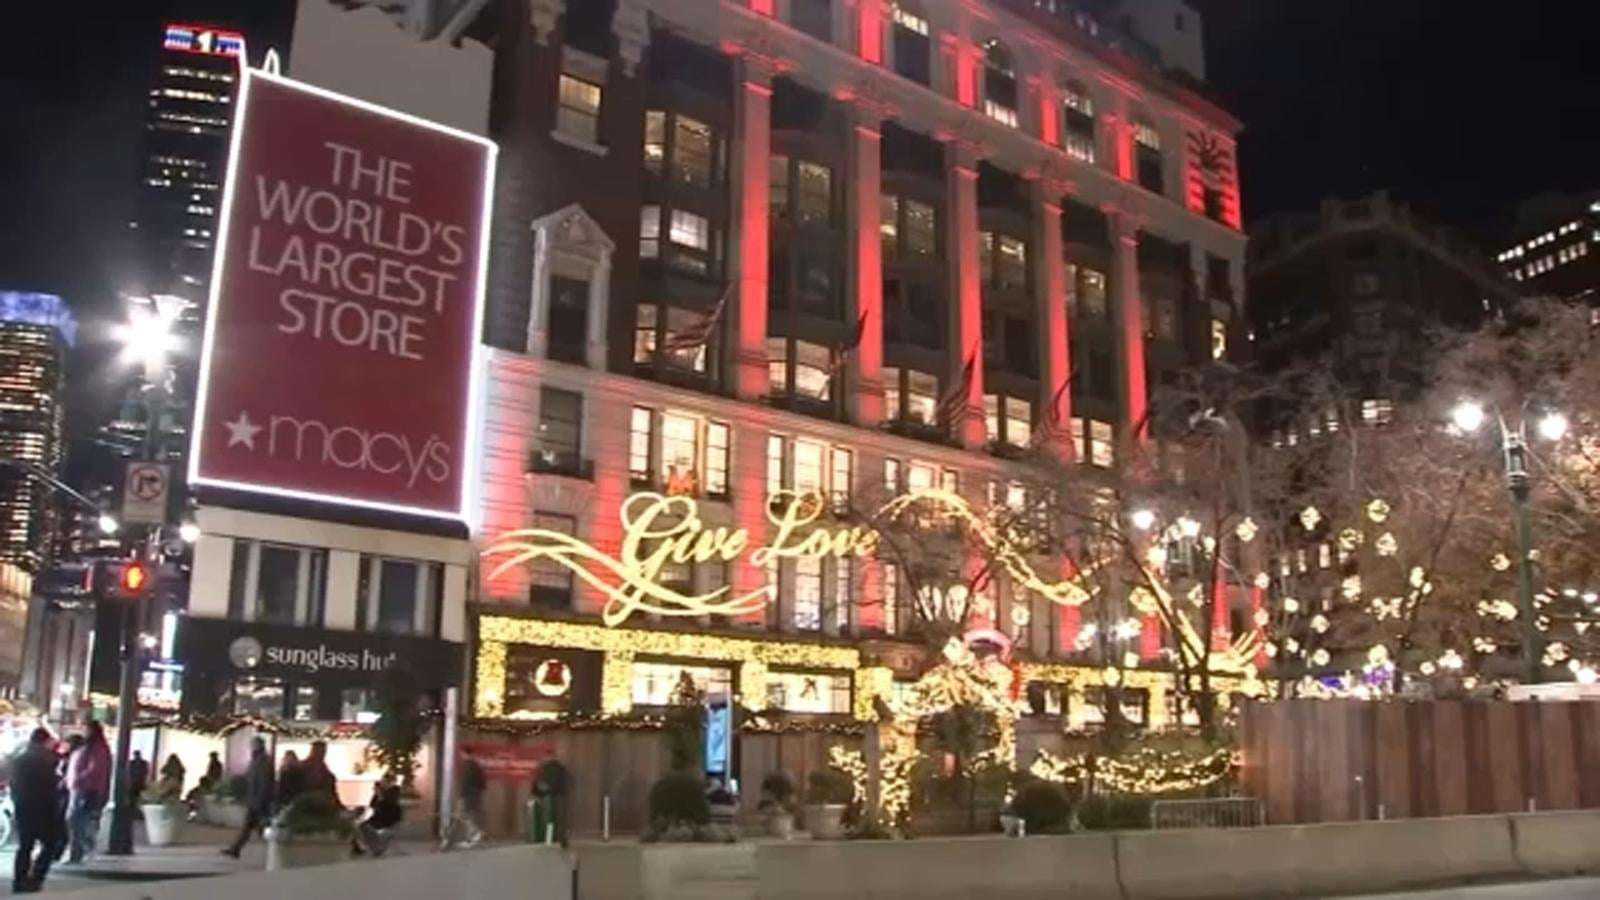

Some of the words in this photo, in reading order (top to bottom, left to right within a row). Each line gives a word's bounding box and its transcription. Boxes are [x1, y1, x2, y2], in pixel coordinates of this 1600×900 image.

[197, 31, 211, 53] 1
[324, 141, 413, 204] THE
[255, 174, 466, 267] WORLD'S
[248, 225, 457, 313] LARGEST
[278, 288, 426, 361] STORE
[268, 415, 451, 488] macy's
[751, 489, 881, 565] Love
[266, 644, 359, 674] sunglass
